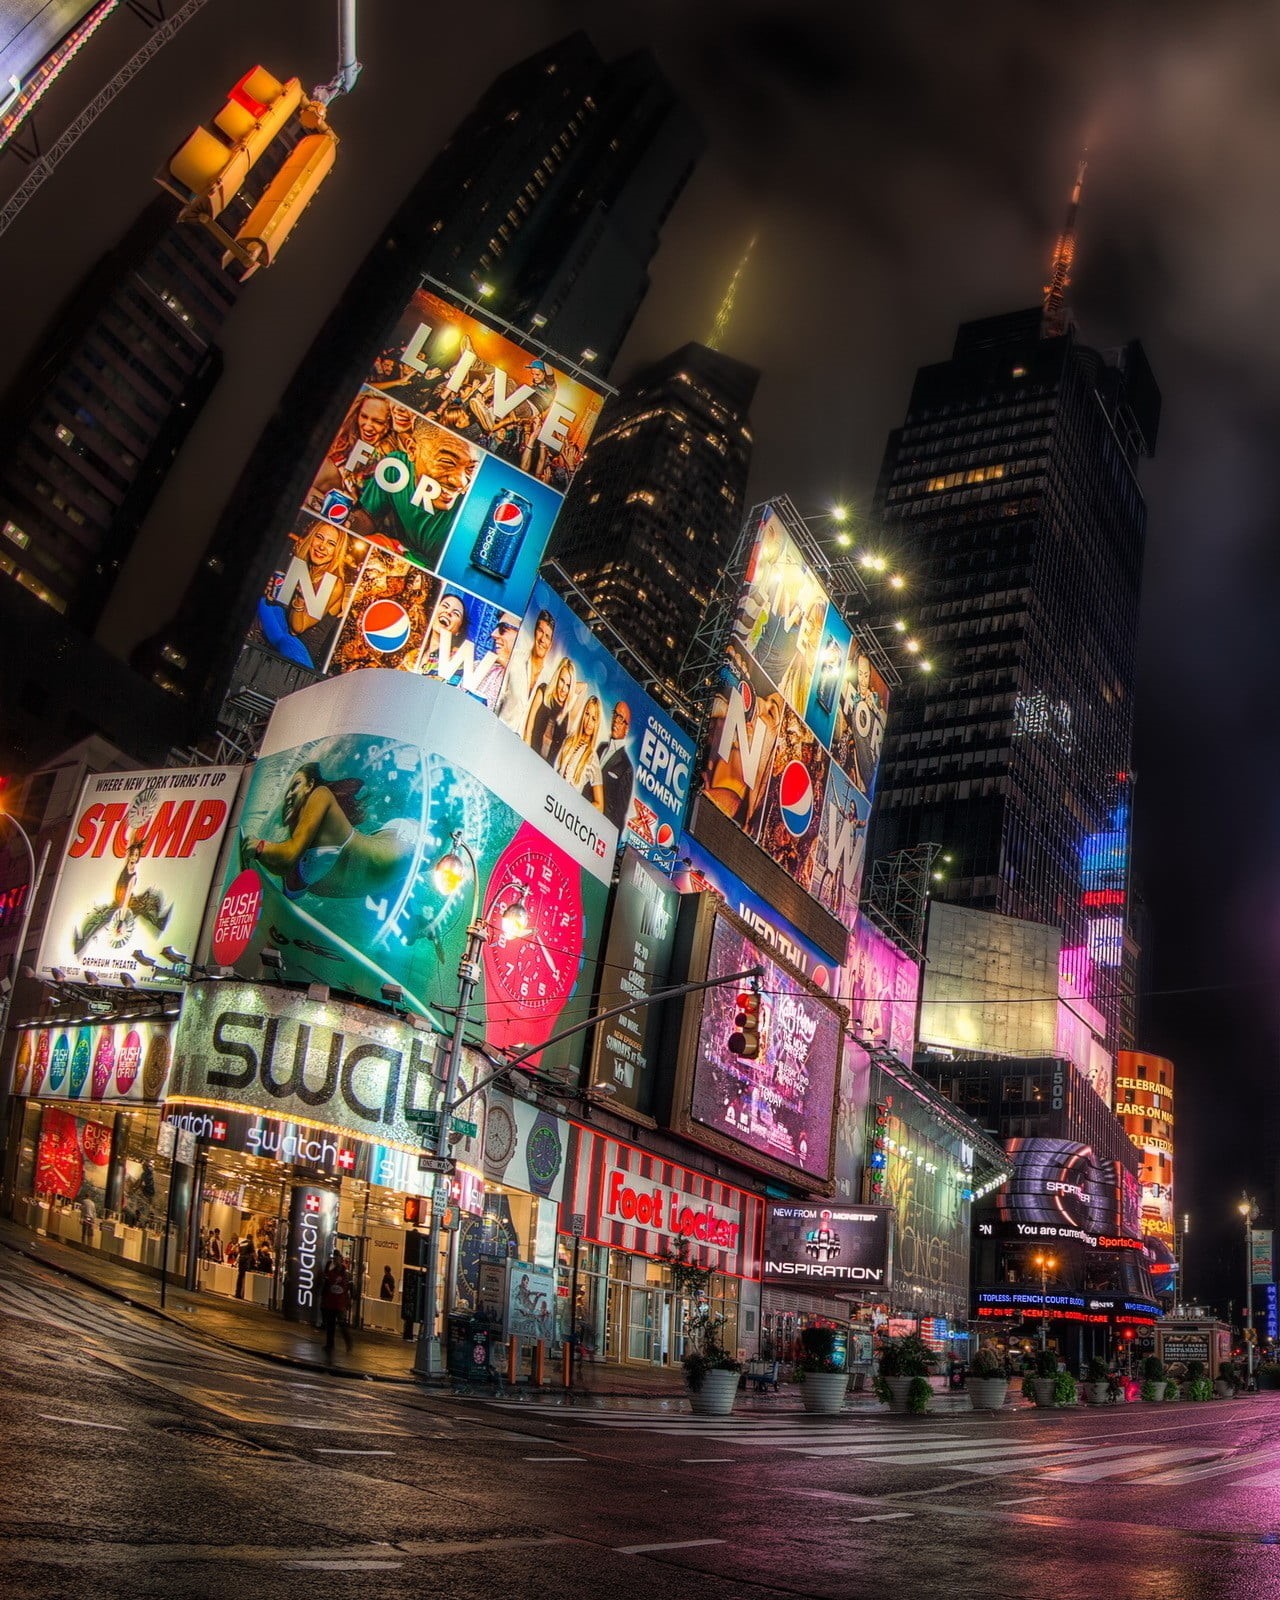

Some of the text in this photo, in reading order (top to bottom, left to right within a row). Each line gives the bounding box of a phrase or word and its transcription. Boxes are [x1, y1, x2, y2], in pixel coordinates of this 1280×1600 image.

[400, 322, 578, 453] LIVE
[343, 439, 442, 516] FOR
[479, 526, 497, 561] pepsi
[843, 680, 887, 756] FOR
[648, 715, 692, 764] CATCH EVERY
[639, 729, 689, 799] EPIC
[95, 773, 227, 792] WHERE NEW YORK TURNS IT UP
[636, 765, 683, 816] MOMENT
[544, 794, 598, 851] swatch
[220, 891, 259, 917] PUSH
[215, 924, 252, 944] OF FUN
[218, 913, 254, 927] THE BUTTON
[112, 958, 137, 970] THEATRE
[1053, 1060, 1063, 1110] 1500
[1116, 1077, 1173, 1099] CELEBRATING
[1147, 1106, 1160, 1119] ON
[246, 1127, 337, 1166] swatch
[422, 1160, 450, 1171] ONE WAY
[608, 1170, 740, 1250] Foot Locker
[773, 1207, 792, 1218] NEW
[793, 1208, 817, 1219] FROM
[1017, 1224, 1057, 1236] You are
[298, 1213, 319, 1307] swatch
[765, 1261, 884, 1280] INSPIRATION
[1013, 1294, 1044, 1304] FRENCH
[1045, 1296, 1068, 1305] COURT
